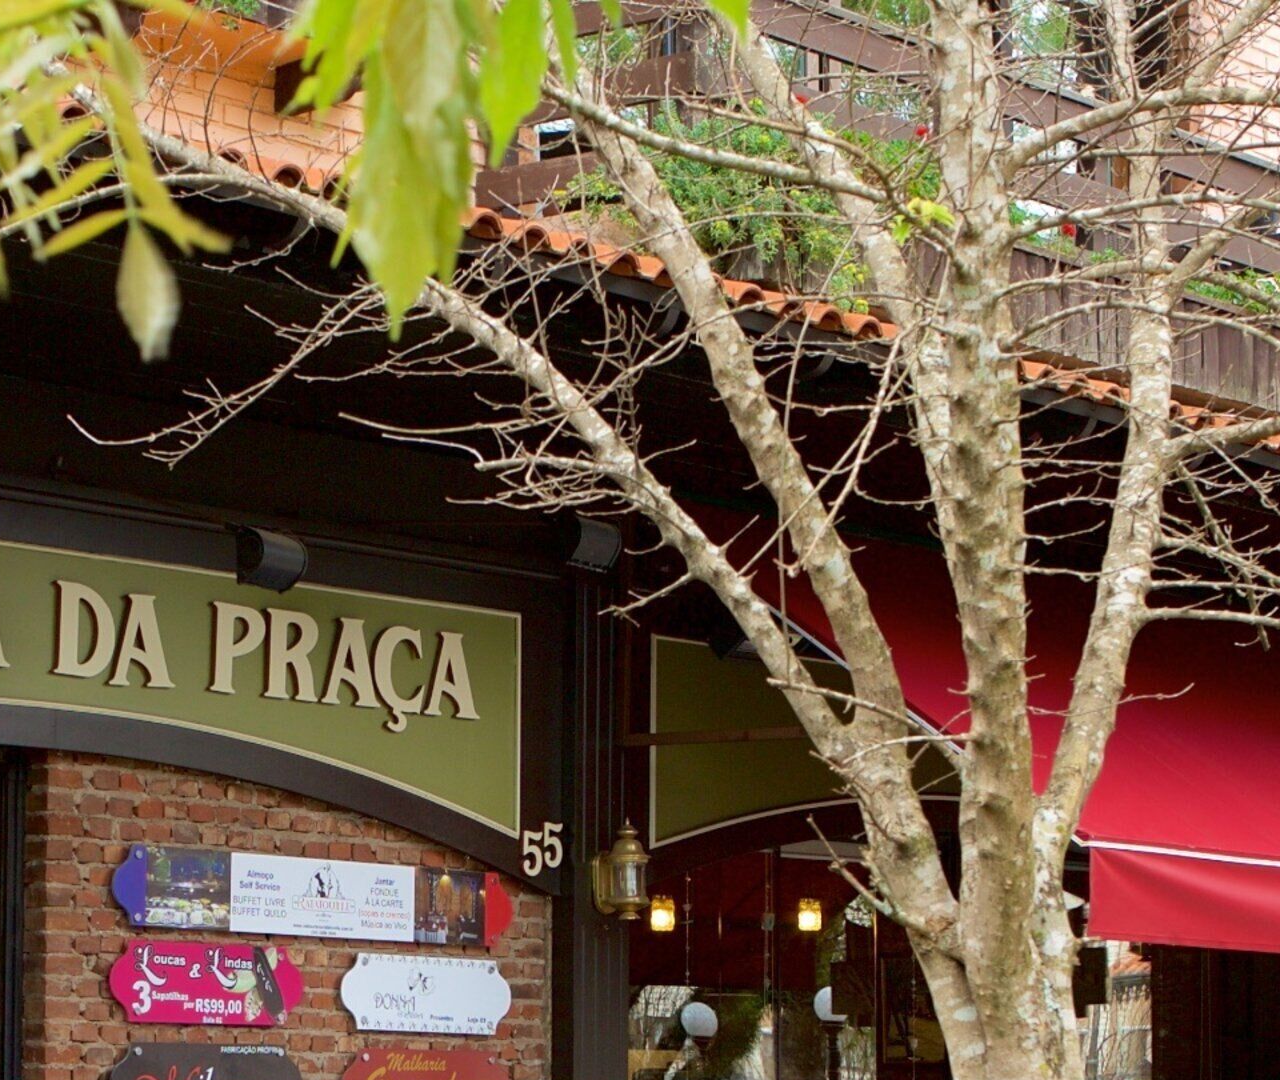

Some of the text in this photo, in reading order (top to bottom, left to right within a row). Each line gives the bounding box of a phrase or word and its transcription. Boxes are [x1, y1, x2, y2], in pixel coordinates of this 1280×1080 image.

[52, 580, 176, 689] DA
[209, 601, 481, 733] PRAÇA
[521, 823, 564, 878] 55
[246, 869, 275, 881] Almoço
[374, 877, 396, 886] Jantar
[239, 880, 282, 892] Self Service
[370, 888, 400, 898] FONDUE
[232, 895, 286, 908] BUFFET LIVRE
[379, 899, 404, 909] CARTE
[232, 906, 288, 919] BUFFET QUILO
[189, 962, 202, 979] &
[204, 947, 253, 989] Lindas
[132, 980, 152, 1016] 3
[195, 998, 242, 1017] R$99,00
[387, 1052, 448, 1072] Malharia
